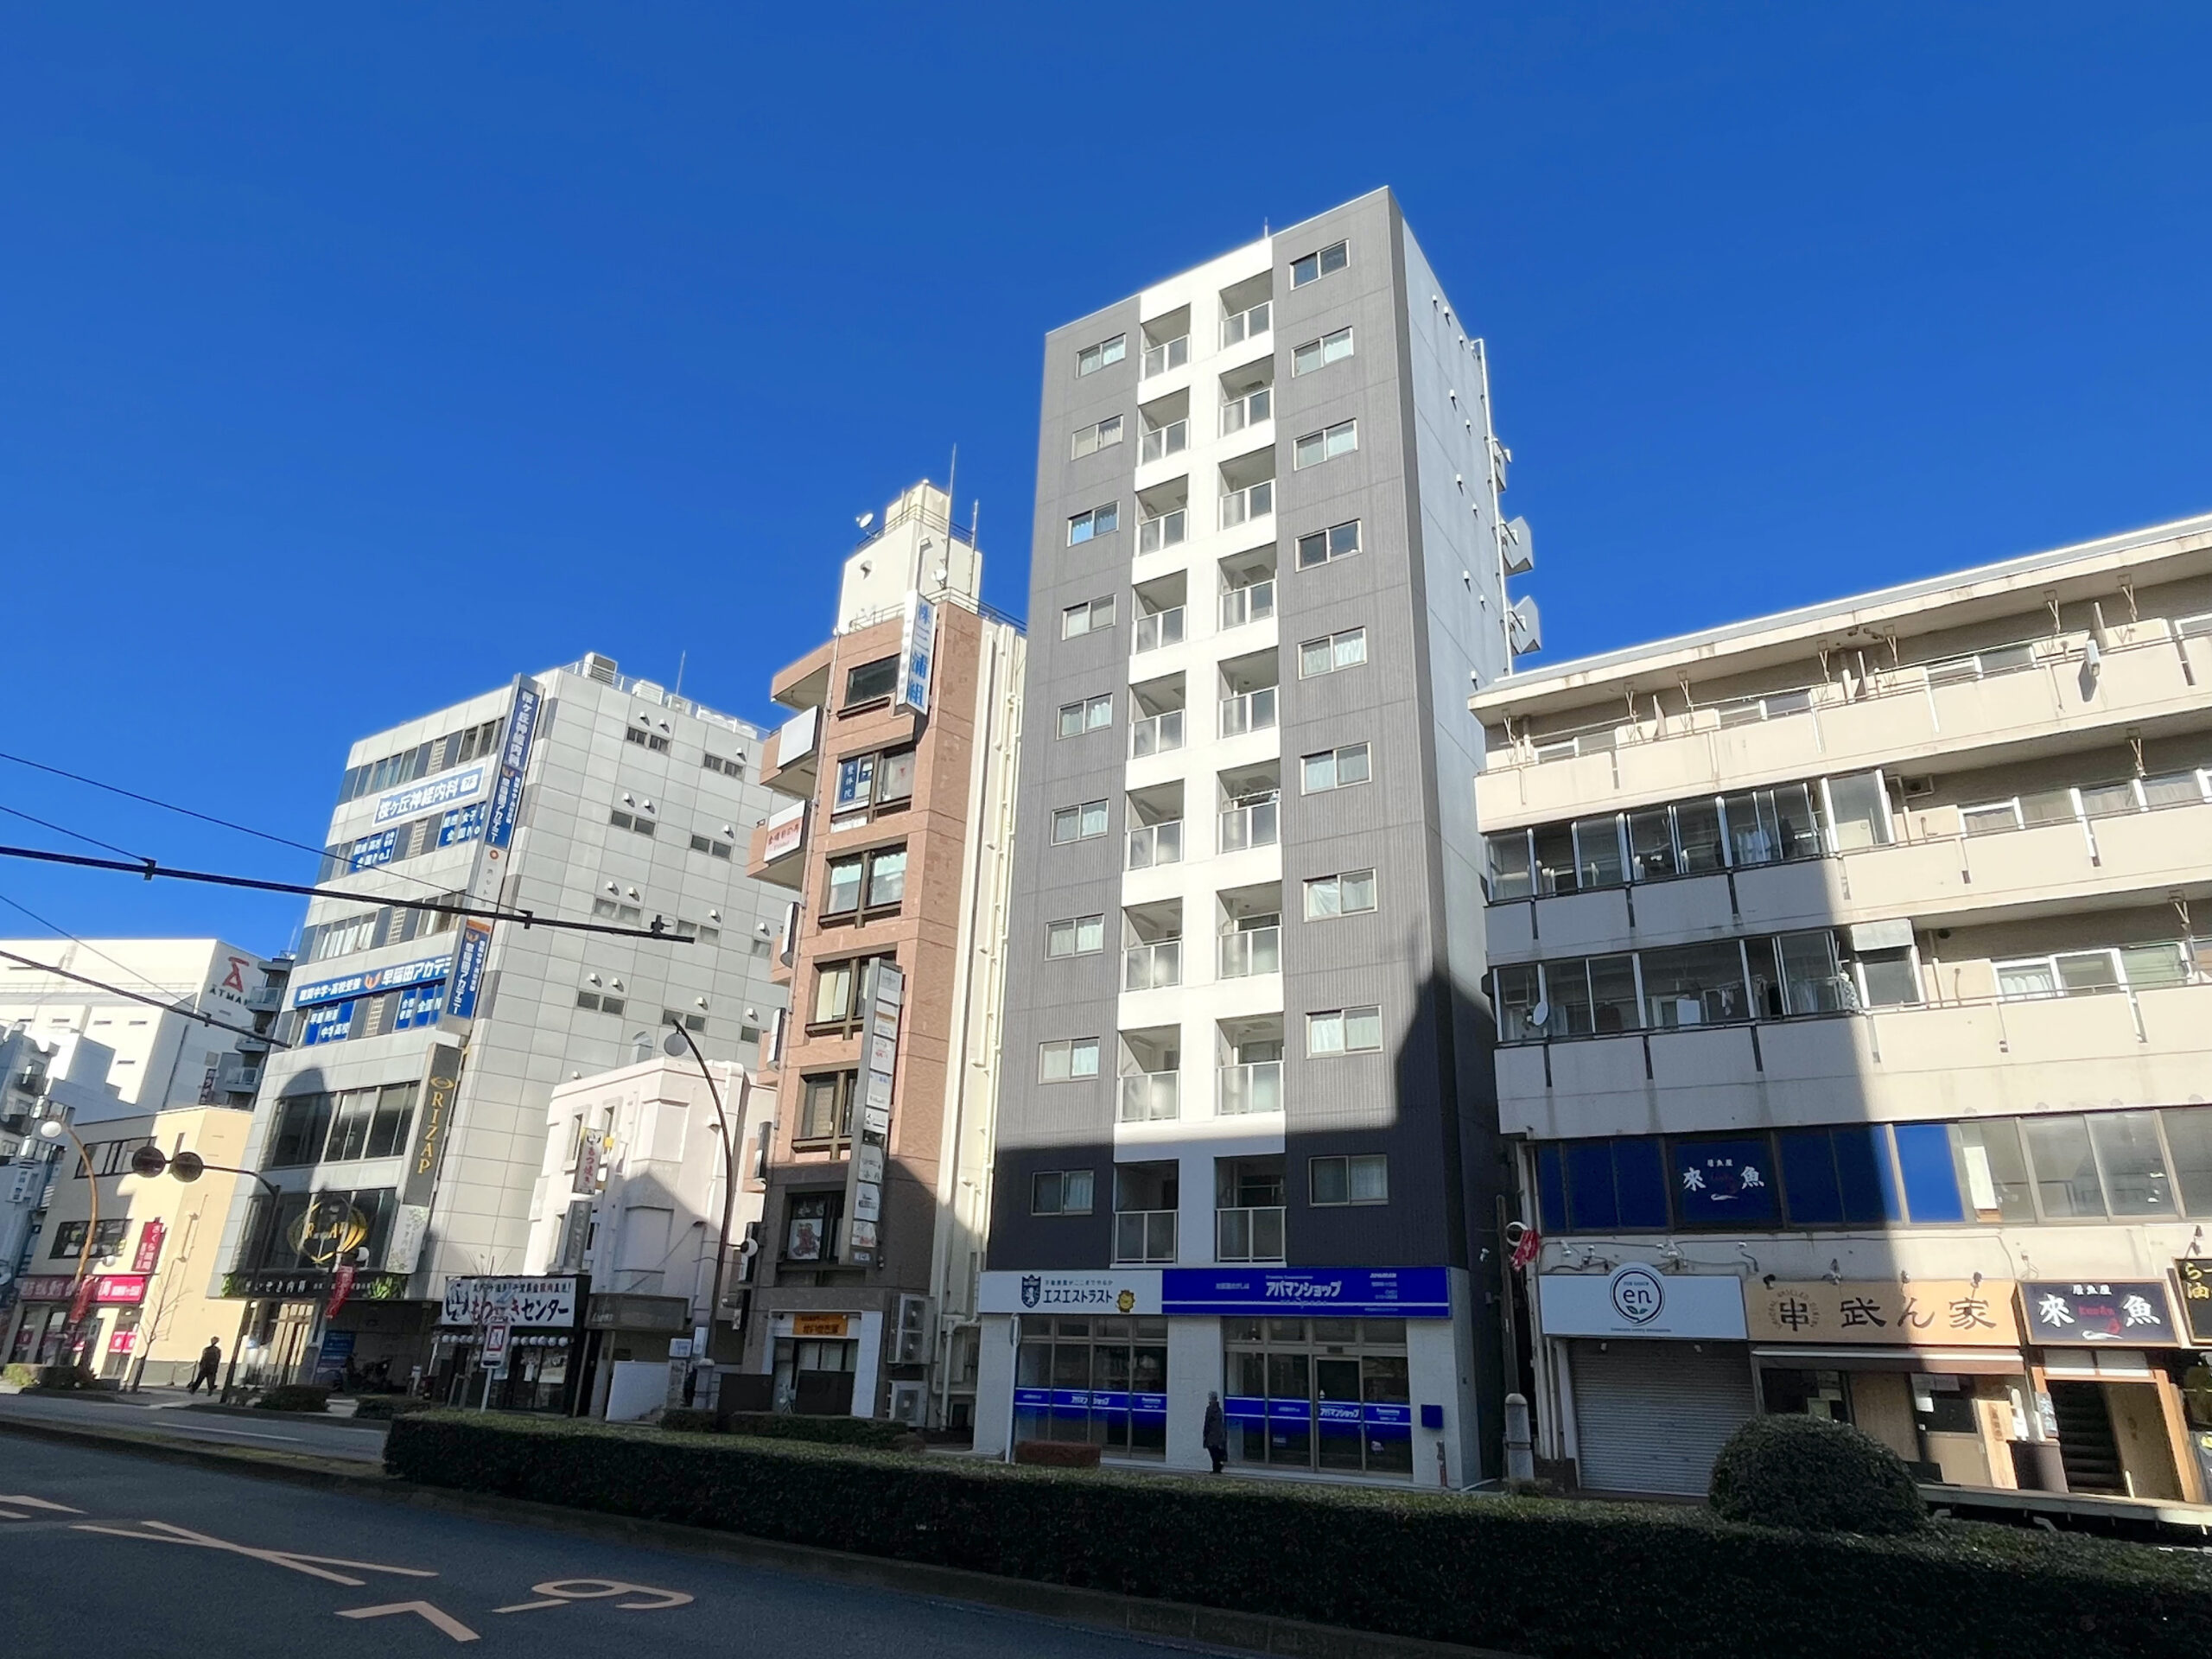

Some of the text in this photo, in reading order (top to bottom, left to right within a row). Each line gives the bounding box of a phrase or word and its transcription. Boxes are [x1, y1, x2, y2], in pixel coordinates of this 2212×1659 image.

[378, 778, 459, 820] 桜ヶ丘神経内科
[418, 1091, 443, 1174] RIZAP
[1043, 1290, 1113, 1304] エスエストラスト
[1265, 1281, 1343, 1297] アパマンショップ
[1623, 1289, 1653, 1304] en
[1780, 1297, 1809, 1332] 串
[1840, 1297, 1997, 1330] 武ん家
[2123, 1294, 2160, 1327] 魚
